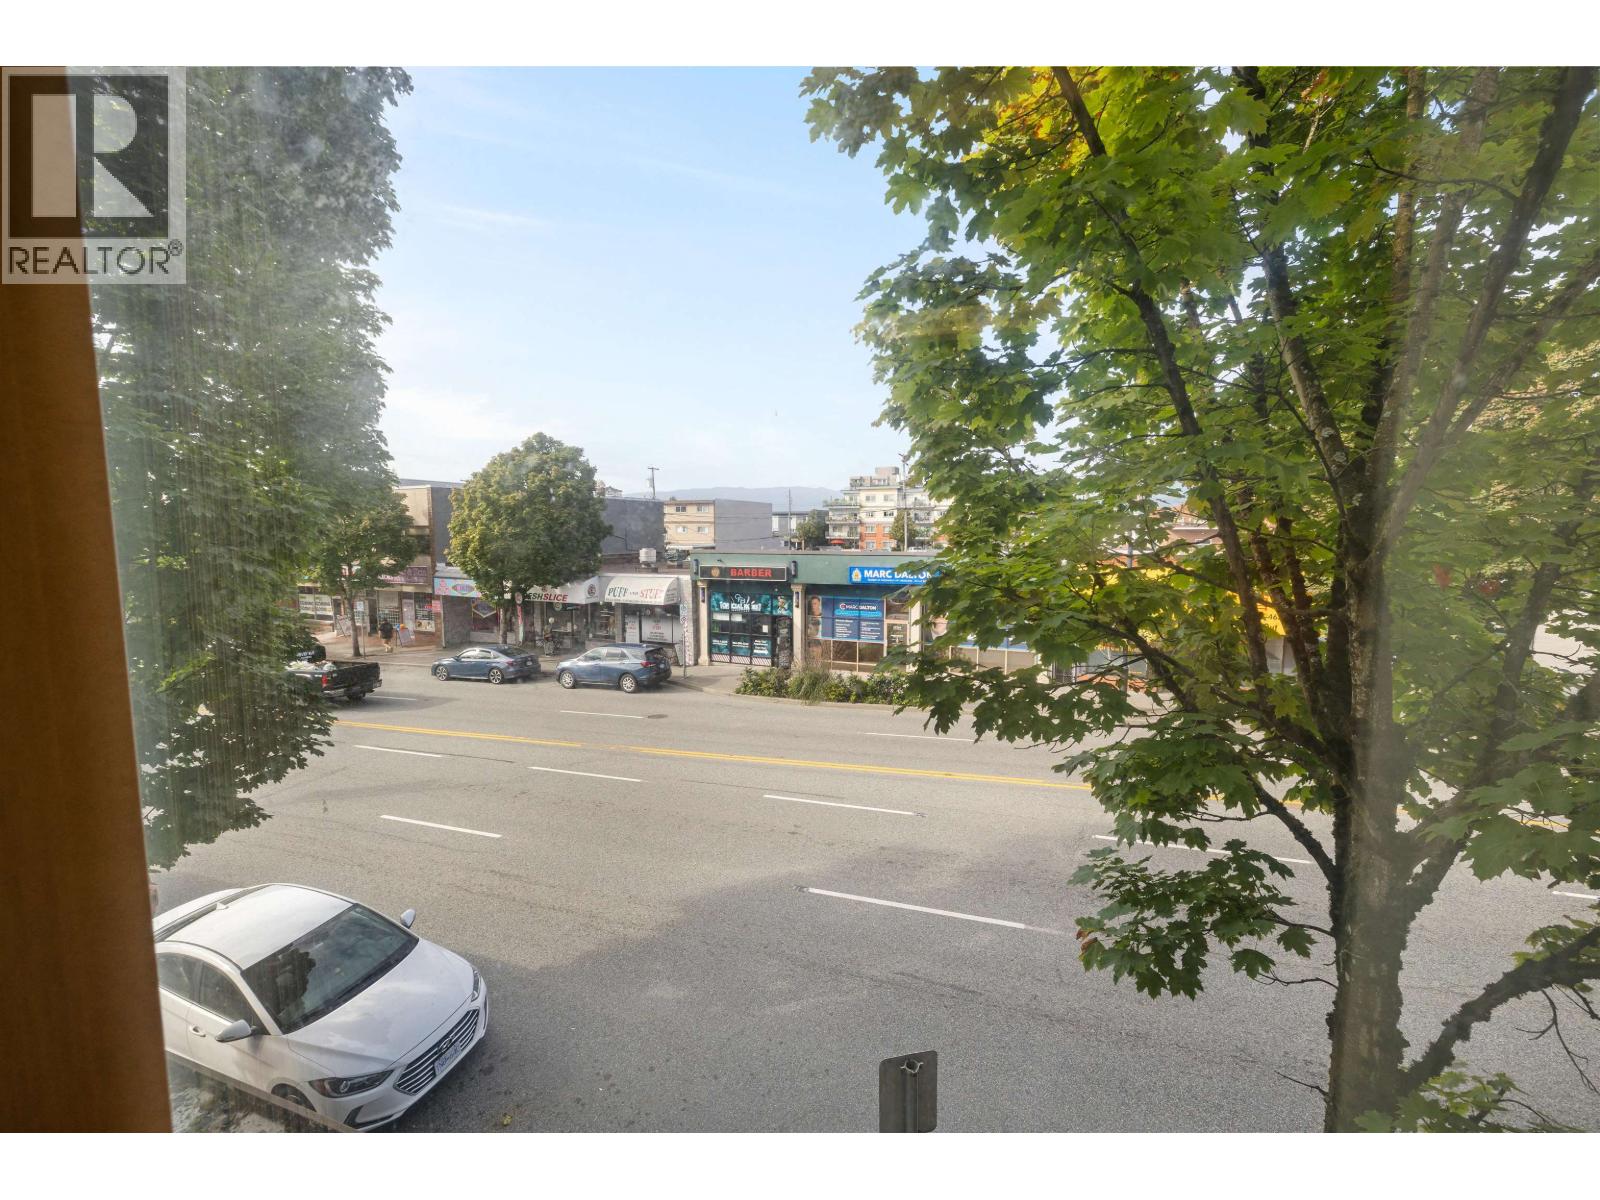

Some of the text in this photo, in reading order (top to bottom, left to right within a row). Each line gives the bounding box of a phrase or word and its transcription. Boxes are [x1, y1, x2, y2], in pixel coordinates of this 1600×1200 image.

[730, 567, 772, 577] BARBER
[864, 569, 892, 579] MARC
[608, 586, 628, 598] PUFF
